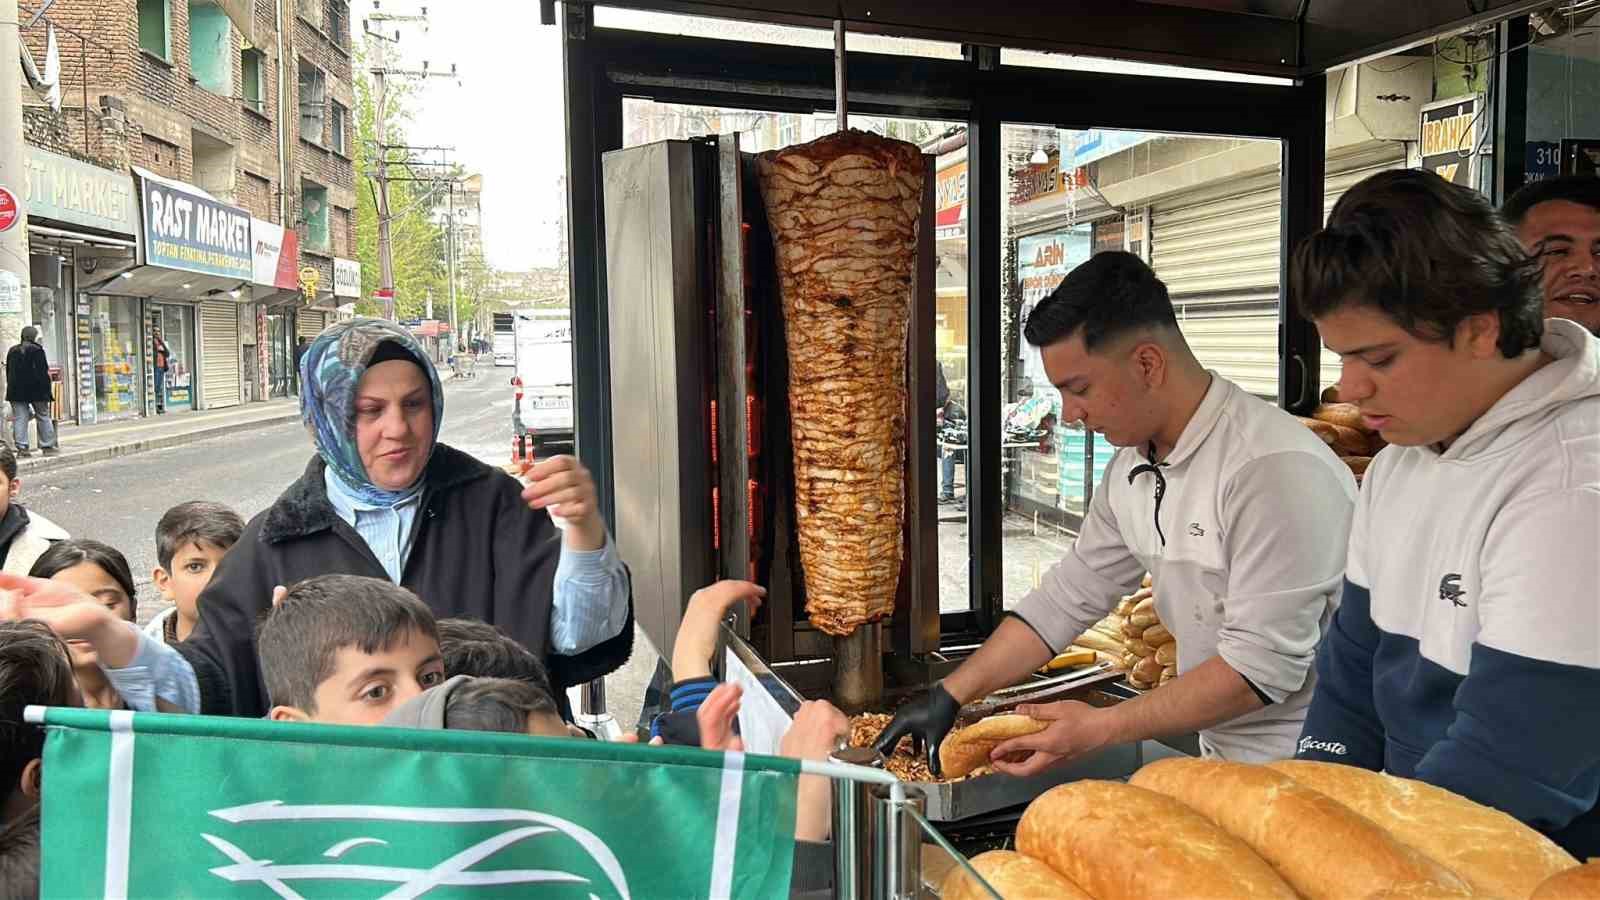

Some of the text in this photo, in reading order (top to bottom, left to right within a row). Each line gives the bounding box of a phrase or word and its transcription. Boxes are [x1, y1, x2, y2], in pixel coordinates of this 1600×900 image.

[1536, 147, 1561, 165] 310
[51, 165, 129, 223] MARKET
[151, 190, 249, 254] RAST MARKET
[152, 239, 178, 260] TOPTAN
[1297, 735, 1349, 755] Lacoste
